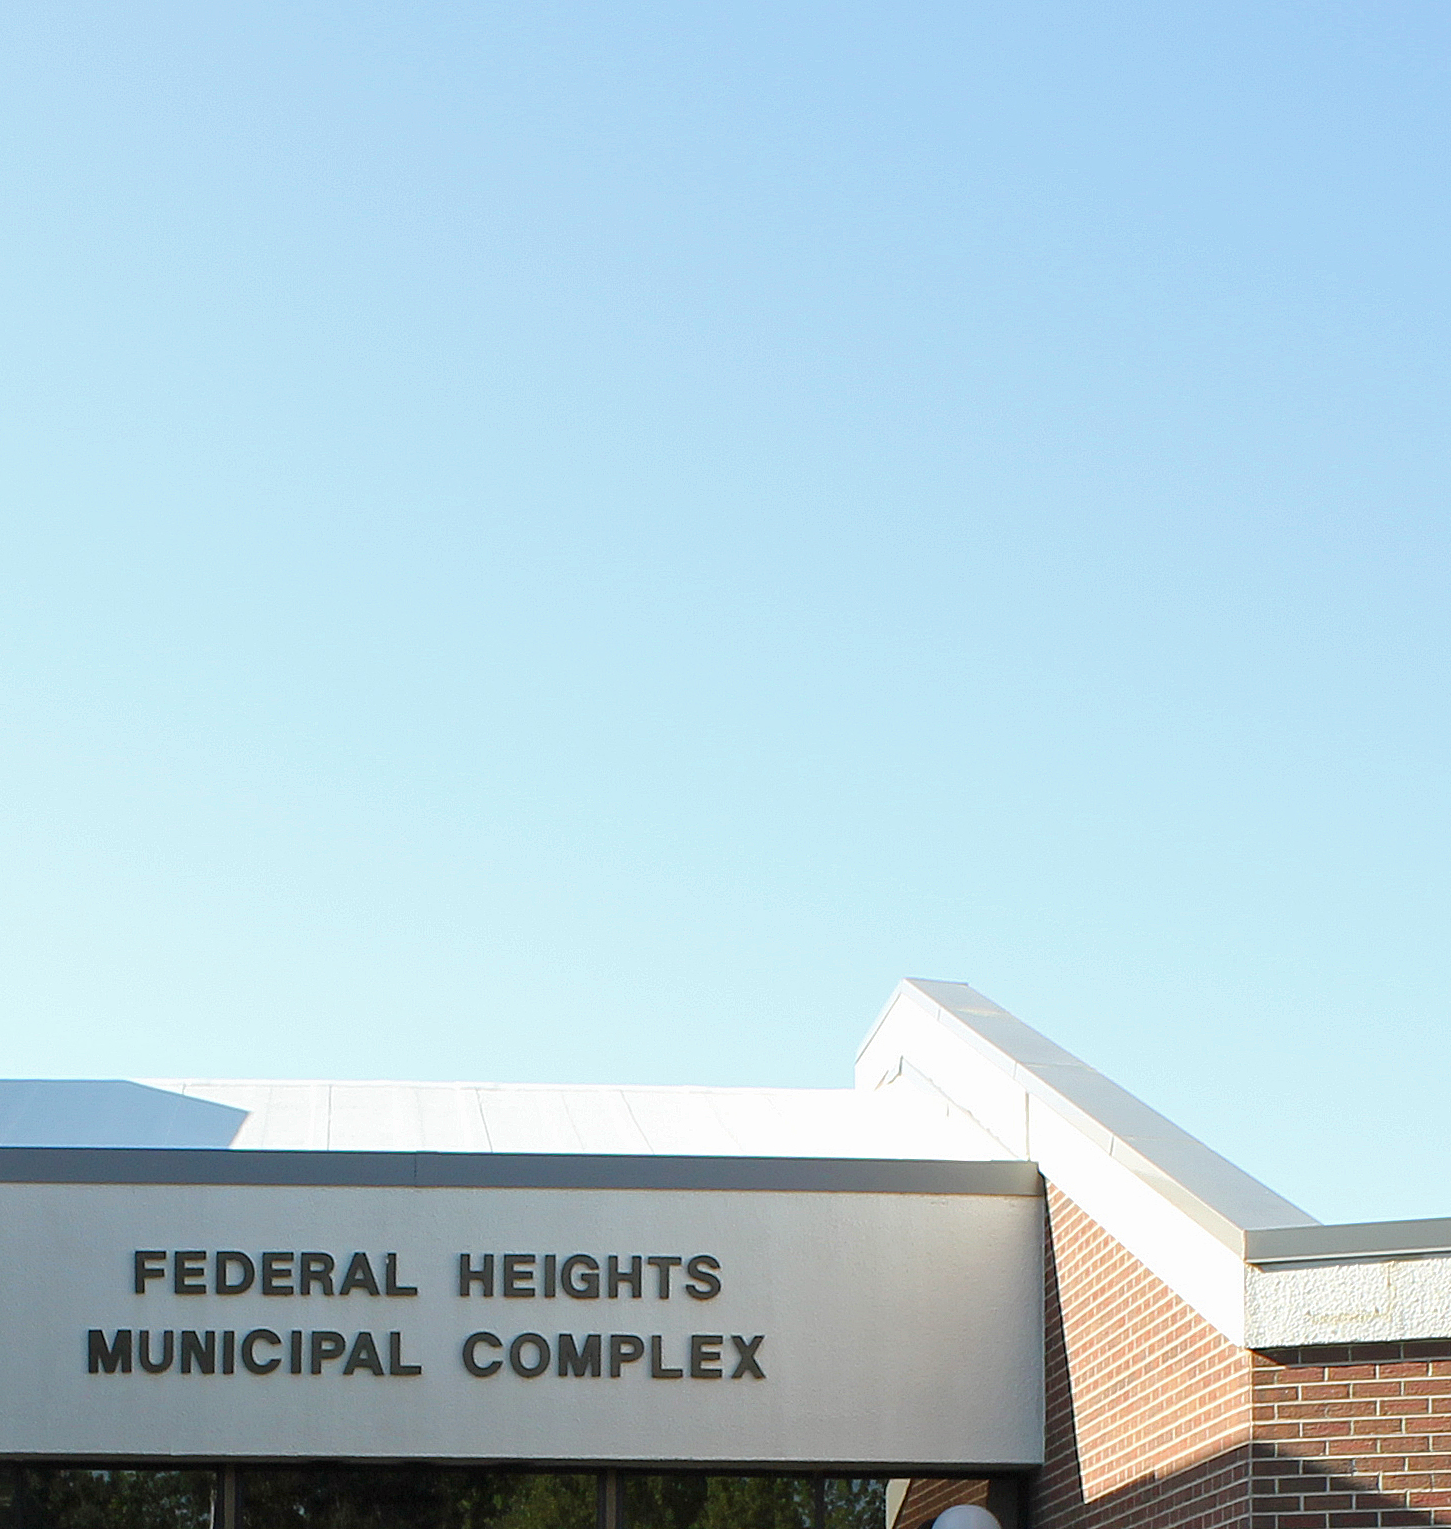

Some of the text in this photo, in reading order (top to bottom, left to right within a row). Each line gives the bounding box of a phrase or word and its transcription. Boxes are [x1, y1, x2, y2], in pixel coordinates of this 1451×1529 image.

[134, 1251, 722, 1300] FEDERAL HEIGHTS
[87, 1329, 767, 1379] MUNICIPAL COMPLEX
